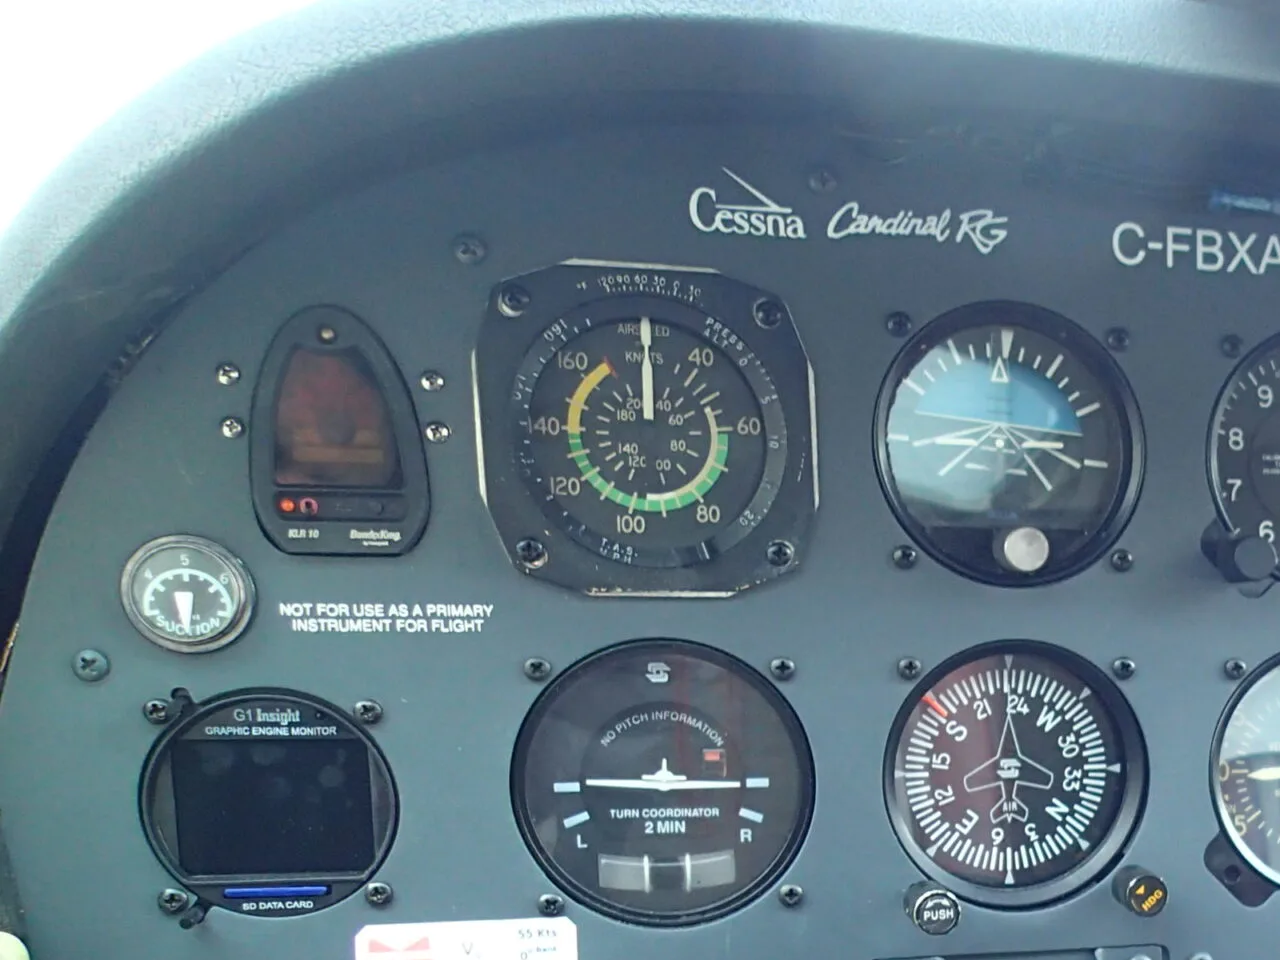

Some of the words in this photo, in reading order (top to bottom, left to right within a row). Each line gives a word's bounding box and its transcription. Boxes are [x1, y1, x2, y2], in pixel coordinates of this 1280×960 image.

[689, 186, 807, 240] Cessna
[827, 201, 950, 242] Cardinal
[955, 208, 1008, 254] RG
[557, 352, 588, 370] 160
[688, 348, 714, 367] 40
[1257, 385, 1274, 408] 9
[616, 409, 636, 421] 180
[527, 417, 560, 435] 140
[737, 417, 760, 435] 60
[670, 440, 686, 452] 80
[1228, 428, 1245, 451] 8
[550, 476, 580, 496] 120
[1227, 479, 1242, 501] 7
[696, 505, 721, 523] 80
[616, 515, 646, 533] 100
[1258, 521, 1275, 544] 6
[180, 554, 190, 566] 5
[220, 572, 229, 585] 6
[279, 603, 314, 617] NOT
[317, 603, 350, 617] FOR
[354, 604, 385, 617] USE
[388, 605, 409, 617] AS
[412, 605, 423, 617] A
[426, 604, 494, 618] PRIMARY
[292, 619, 392, 632] INSTRUMENT
[396, 620, 428, 633] FOR
[431, 620, 484, 633] FLIGHT
[973, 699, 992, 720] 21
[1006, 696, 1030, 715] 24
[234, 709, 252, 722] G1
[256, 709, 301, 725] Insight
[1036, 704, 1062, 733] W
[205, 726, 250, 736] GRAPHIC
[252, 726, 289, 736] ENGINE
[291, 726, 337, 736] MONITOR
[600, 730, 618, 747] NO
[614, 713, 650, 734] PITCH
[650, 710, 725, 748] INFORMATION
[946, 720, 969, 742] S
[1058, 733, 1079, 759] 30
[932, 752, 951, 770] 15
[1062, 766, 1082, 792] 33
[934, 785, 956, 806] 12
[610, 809, 640, 819] TURN
[642, 808, 721, 819] COORDINATOR
[1045, 797, 1070, 821] N
[644, 821, 655, 834] 2
[656, 820, 687, 834] MIN
[955, 808, 979, 836] E
[1234, 814, 1247, 837] 5
[740, 829, 753, 843] R
[991, 827, 1005, 845] 6
[1024, 822, 1039, 841] 3
[577, 835, 588, 848] L
[242, 902, 258, 911] SD
[259, 902, 285, 911] DATA
[286, 901, 314, 910] CARD
[1141, 889, 1163, 912] HDG
[923, 909, 954, 921] PUSH
